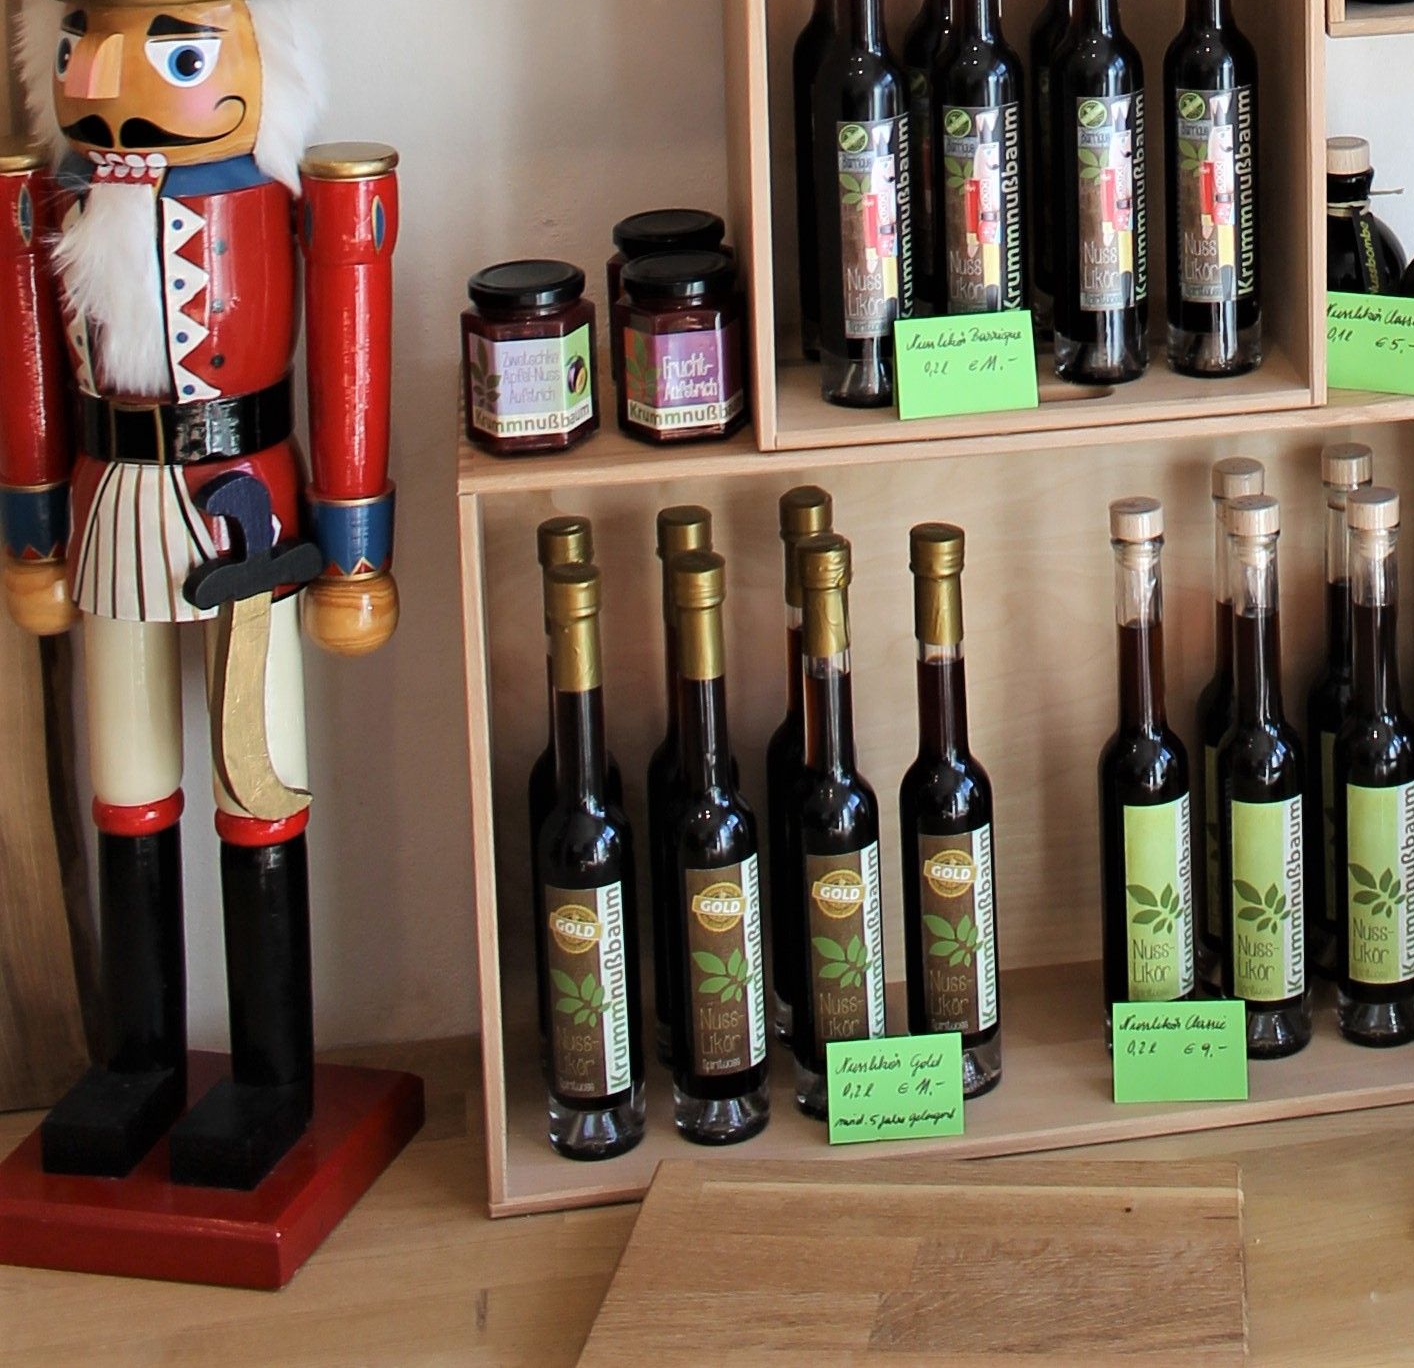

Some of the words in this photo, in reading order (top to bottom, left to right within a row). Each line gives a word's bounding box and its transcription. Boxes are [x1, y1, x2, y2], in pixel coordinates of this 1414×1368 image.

[1133, 96, 1146, 300] Krummnußbaum
[1235, 90, 1254, 295] Krummnußbaum
[1084, 242, 1117, 264] Nuss
[1184, 233, 1217, 256] Nuss
[950, 251, 982, 275] Nuss
[848, 268, 882, 291] Nuss
[663, 352, 713, 379] Frucht-
[664, 380, 719, 402] Aufstrich
[931, 866, 971, 880] GOLD
[820, 886, 860, 900] GOLD
[1287, 799, 1303, 993] Krummnußbaum
[700, 900, 741, 913] GOLD
[555, 920, 595, 938] GOLD
[978, 829, 995, 1024] Krummnußbaum
[1353, 917, 1394, 940] Nuss-
[1133, 939, 1174, 960] Nuss-
[1238, 934, 1280, 957] Nuss-
[1353, 941, 1390, 964] Likör
[930, 970, 973, 992] Nuss-
[1133, 962, 1170, 983] Likör
[1238, 959, 1275, 981] Likör
[604, 885, 630, 1088] Krummnußbaum
[819, 993, 865, 1014] Nuss-
[700, 1006, 743, 1030] Nuss-
[1184, 1044, 1194, 1054] €
[898, 1083, 908, 1093] €
